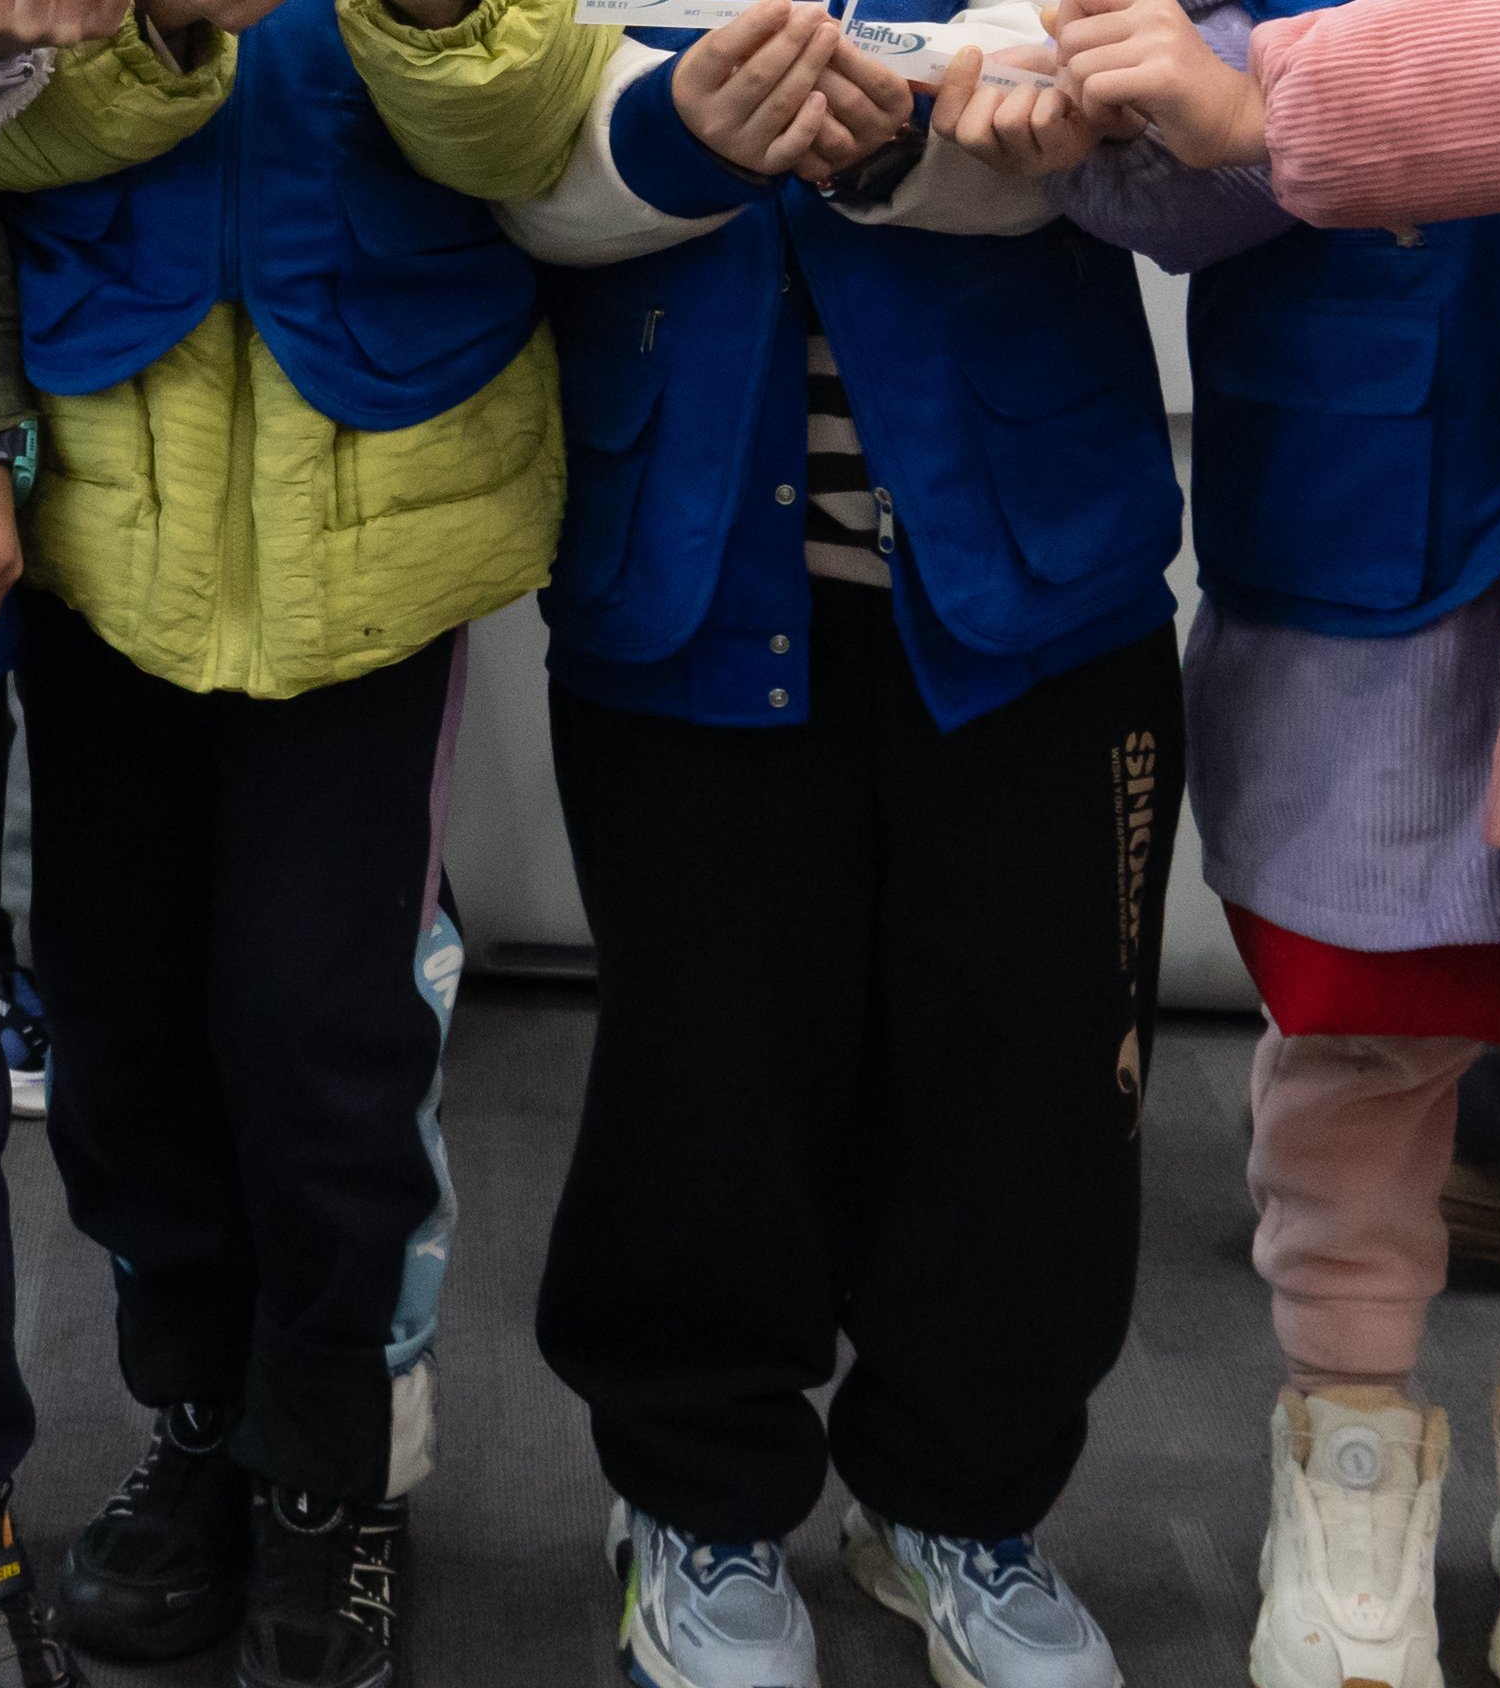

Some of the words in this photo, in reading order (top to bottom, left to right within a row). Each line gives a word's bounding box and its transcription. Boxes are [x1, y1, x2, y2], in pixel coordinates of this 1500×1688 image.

[845, 18, 902, 47] Haifu
[1111, 746, 1121, 783] WISH
[1114, 787, 1124, 813] YOU
[1116, 818, 1127, 893] HAPPINESS
